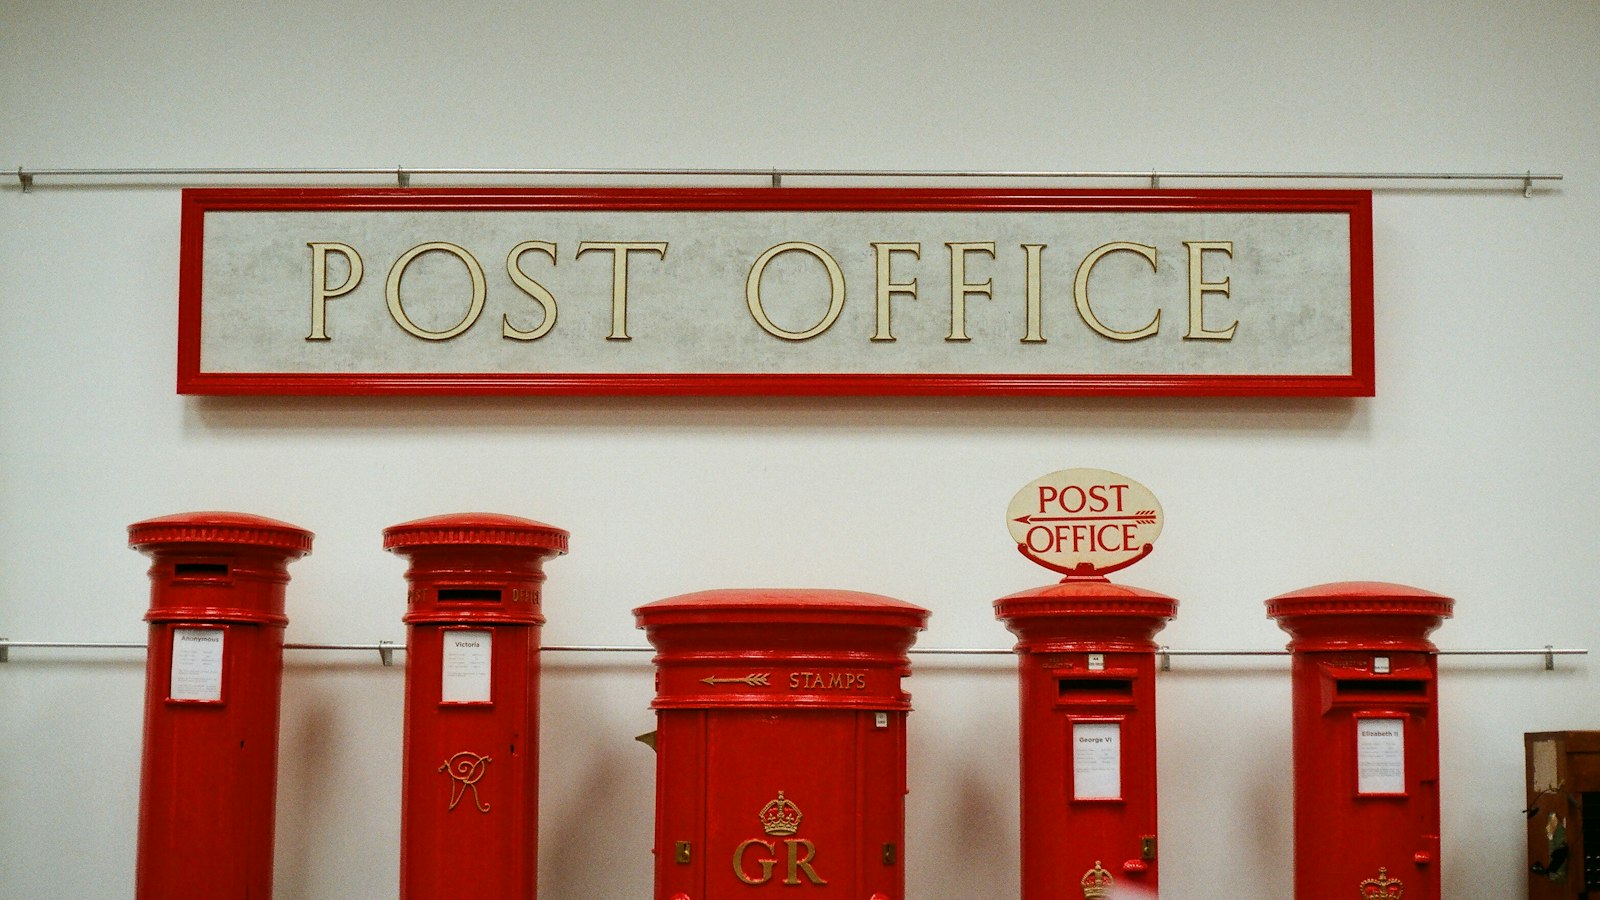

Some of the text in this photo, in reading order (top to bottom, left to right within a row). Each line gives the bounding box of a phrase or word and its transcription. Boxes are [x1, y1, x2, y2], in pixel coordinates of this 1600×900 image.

[305, 240, 1239, 343] POST OFFICE
[1038, 484, 1130, 513] POST
[1026, 523, 1141, 553] OFFICE
[181, 635, 219, 643] Anonymous
[788, 672, 867, 690] STAMPS
[732, 837, 829, 886] GR
